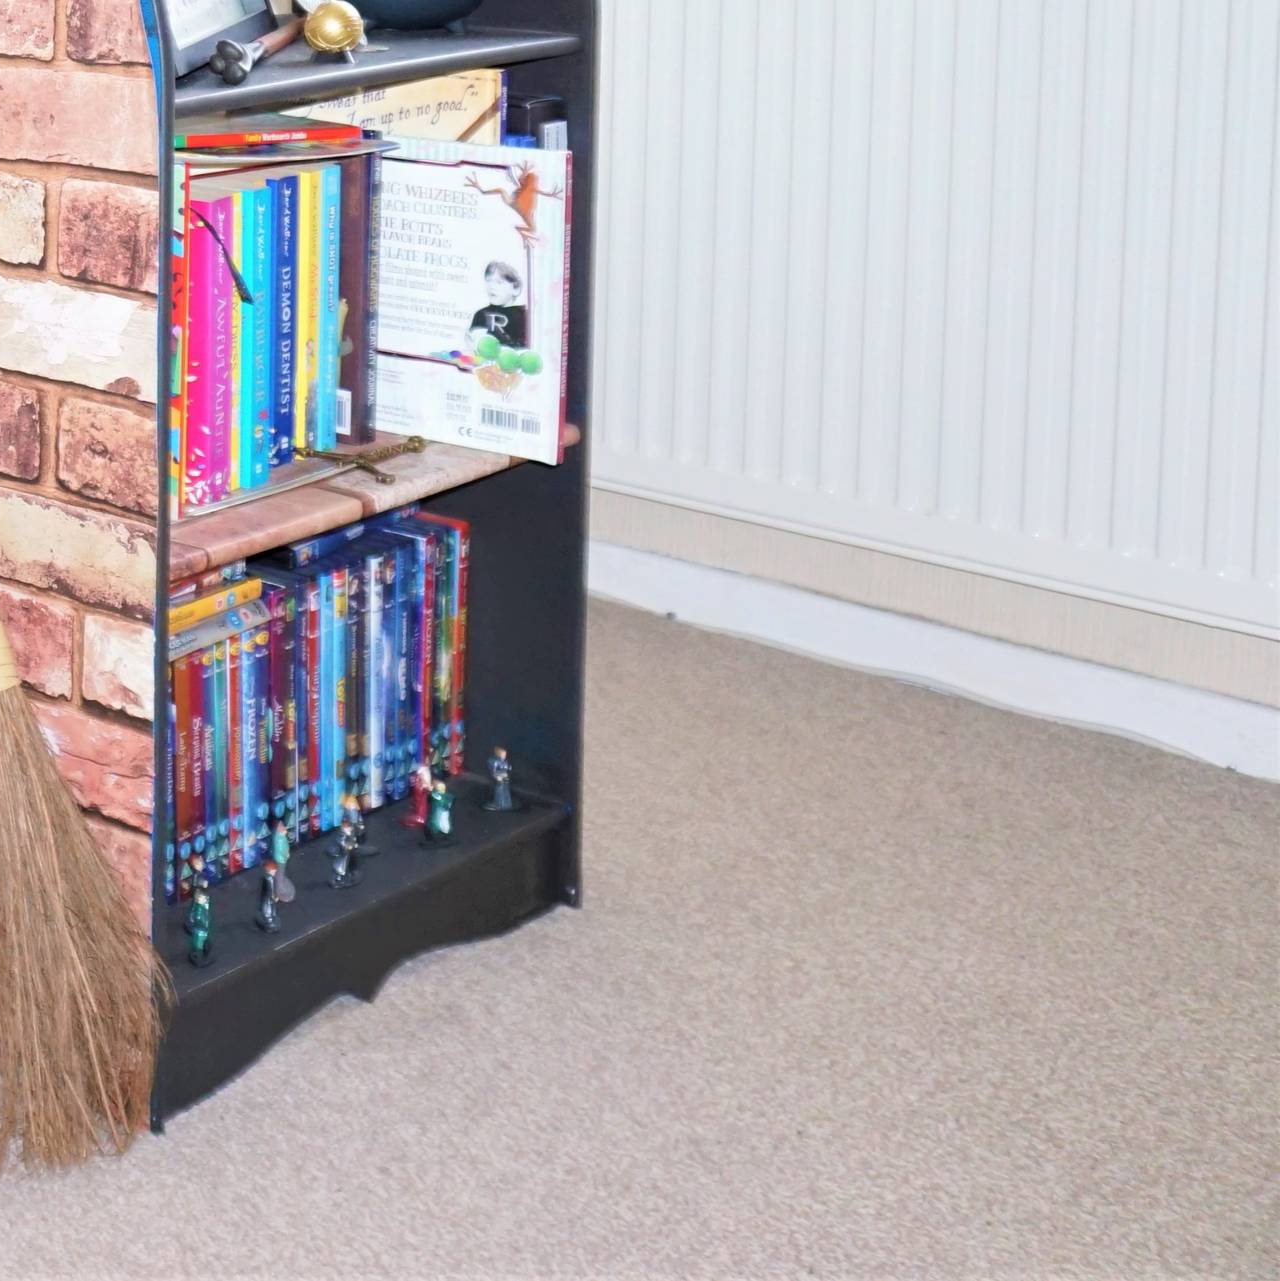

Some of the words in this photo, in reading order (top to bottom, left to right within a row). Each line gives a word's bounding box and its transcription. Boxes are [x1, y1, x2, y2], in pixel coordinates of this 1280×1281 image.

[381, 112, 394, 135] up
[398, 105, 411, 121] to
[416, 104, 431, 117] no
[279, 266, 291, 334] DEMON
[368, 320, 377, 366] CREATIVITY
[486, 313, 509, 334] R
[279, 338, 291, 415] DENTIST
[367, 368, 377, 407] JOURNAL
[246, 697, 257, 760] FROZEN
